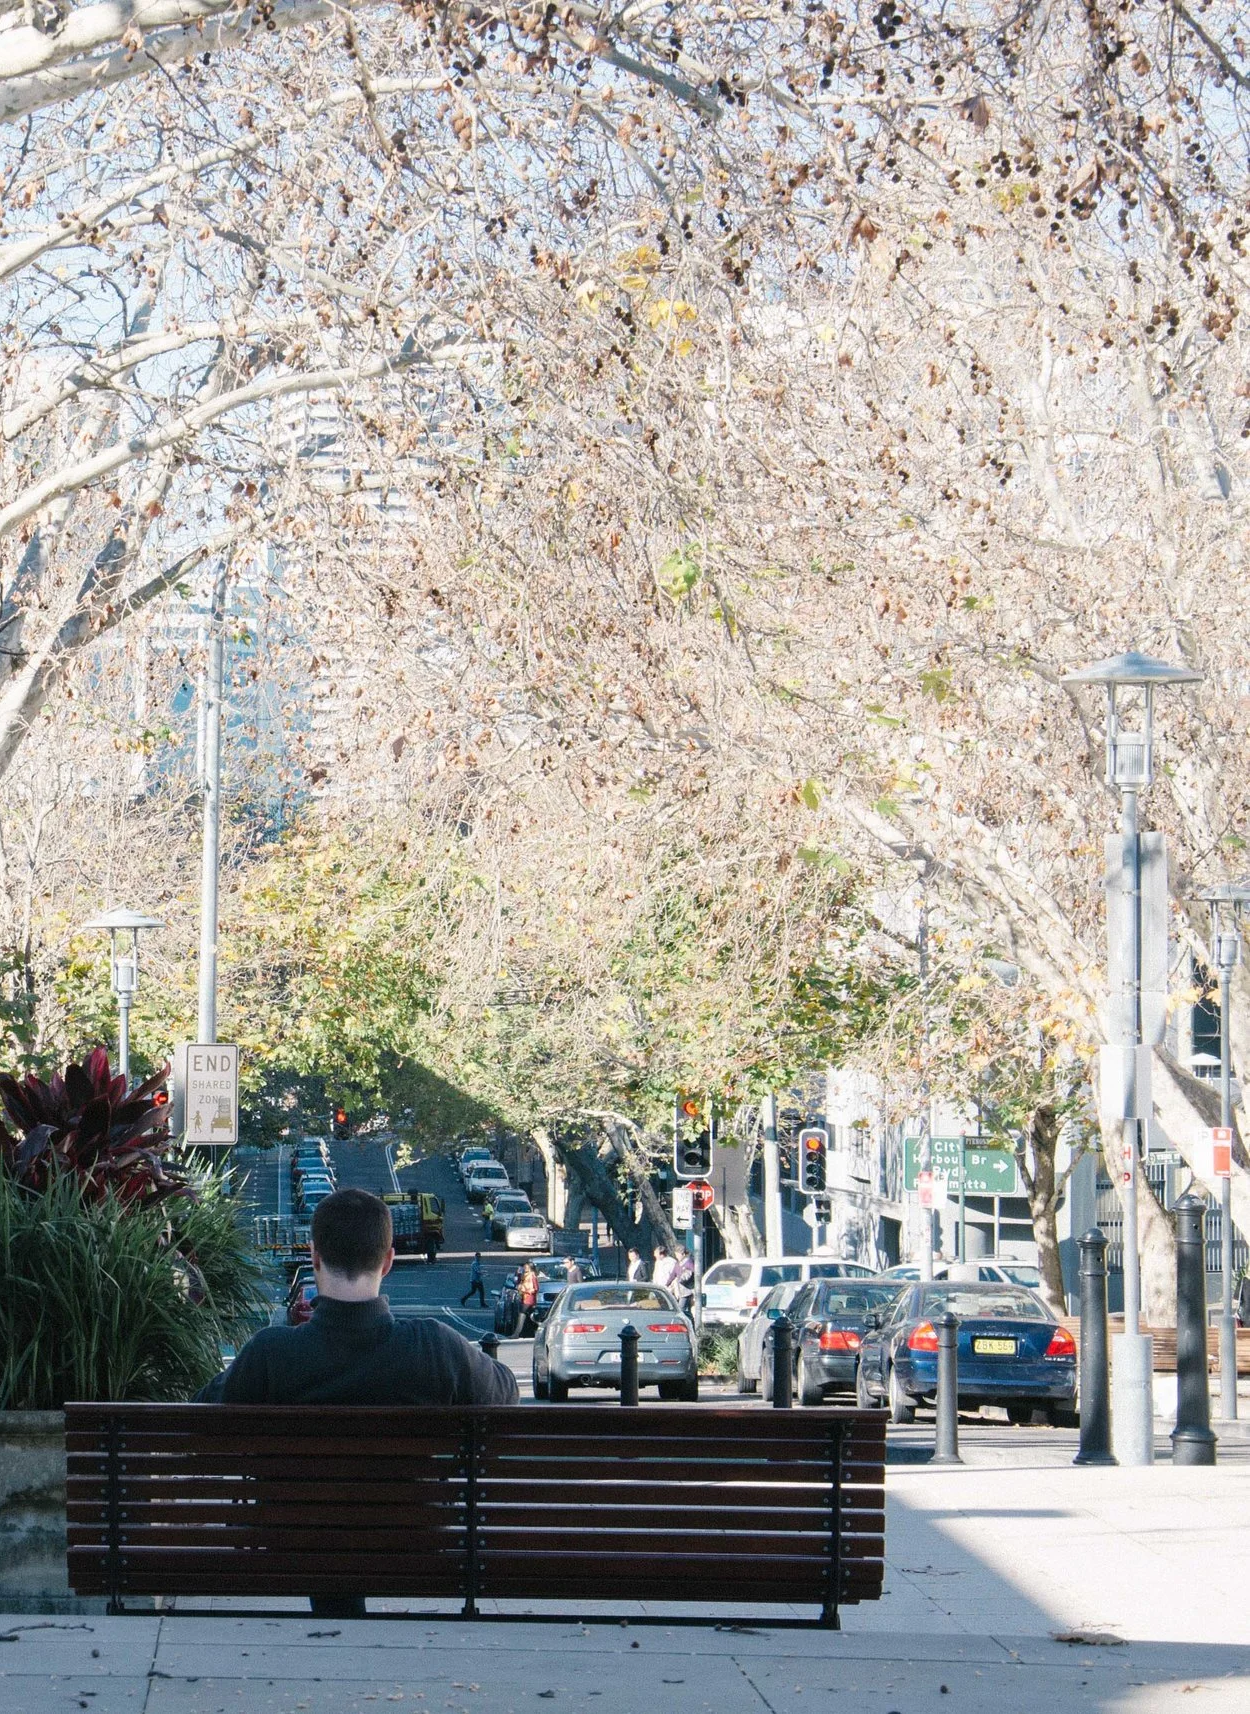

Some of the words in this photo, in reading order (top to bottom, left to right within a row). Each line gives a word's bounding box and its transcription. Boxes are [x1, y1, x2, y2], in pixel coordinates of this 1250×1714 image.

[193, 1055, 231, 1072] END
[191, 1080, 231, 1090] SHARED
[912, 1153, 961, 1165] Hrbou
[971, 1154, 987, 1165] Br
[692, 1189, 712, 1201] TOP
